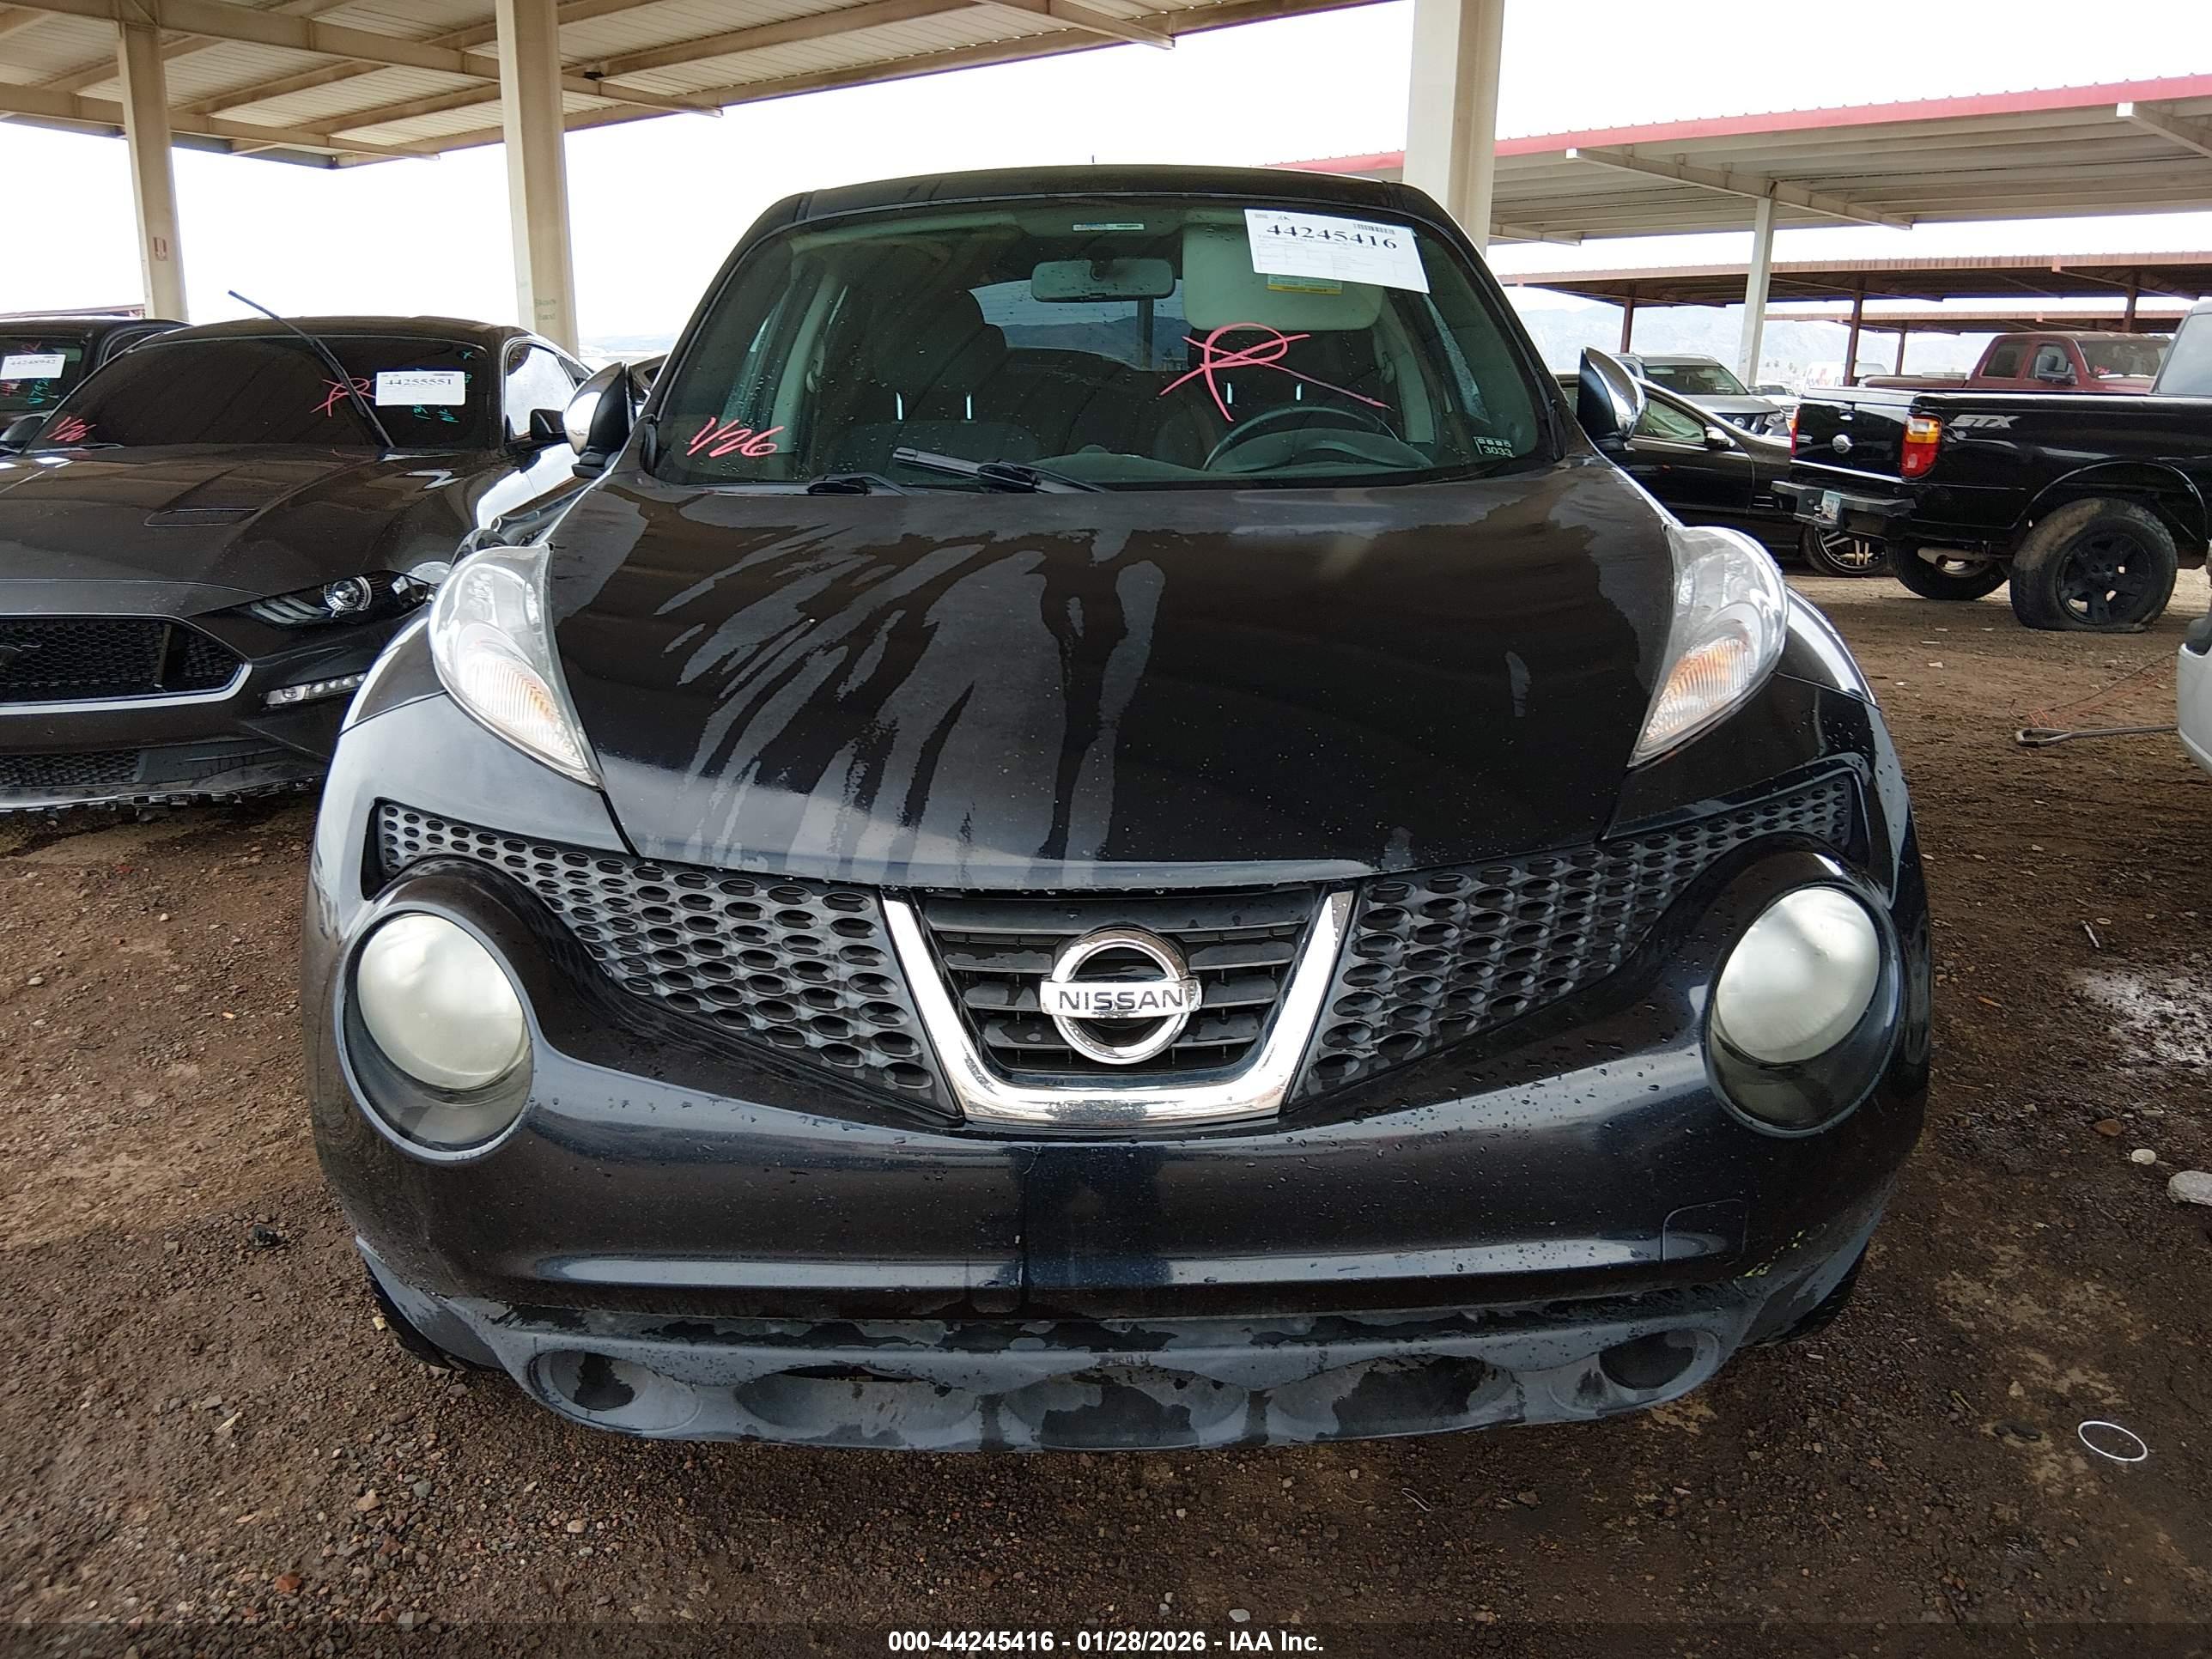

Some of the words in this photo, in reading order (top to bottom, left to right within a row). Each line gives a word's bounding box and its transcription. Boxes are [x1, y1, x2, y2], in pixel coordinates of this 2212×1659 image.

[1267, 224, 1397, 250] 44245416
[1948, 414, 2020, 428] STX
[1059, 988, 1183, 1011] NISSAN
